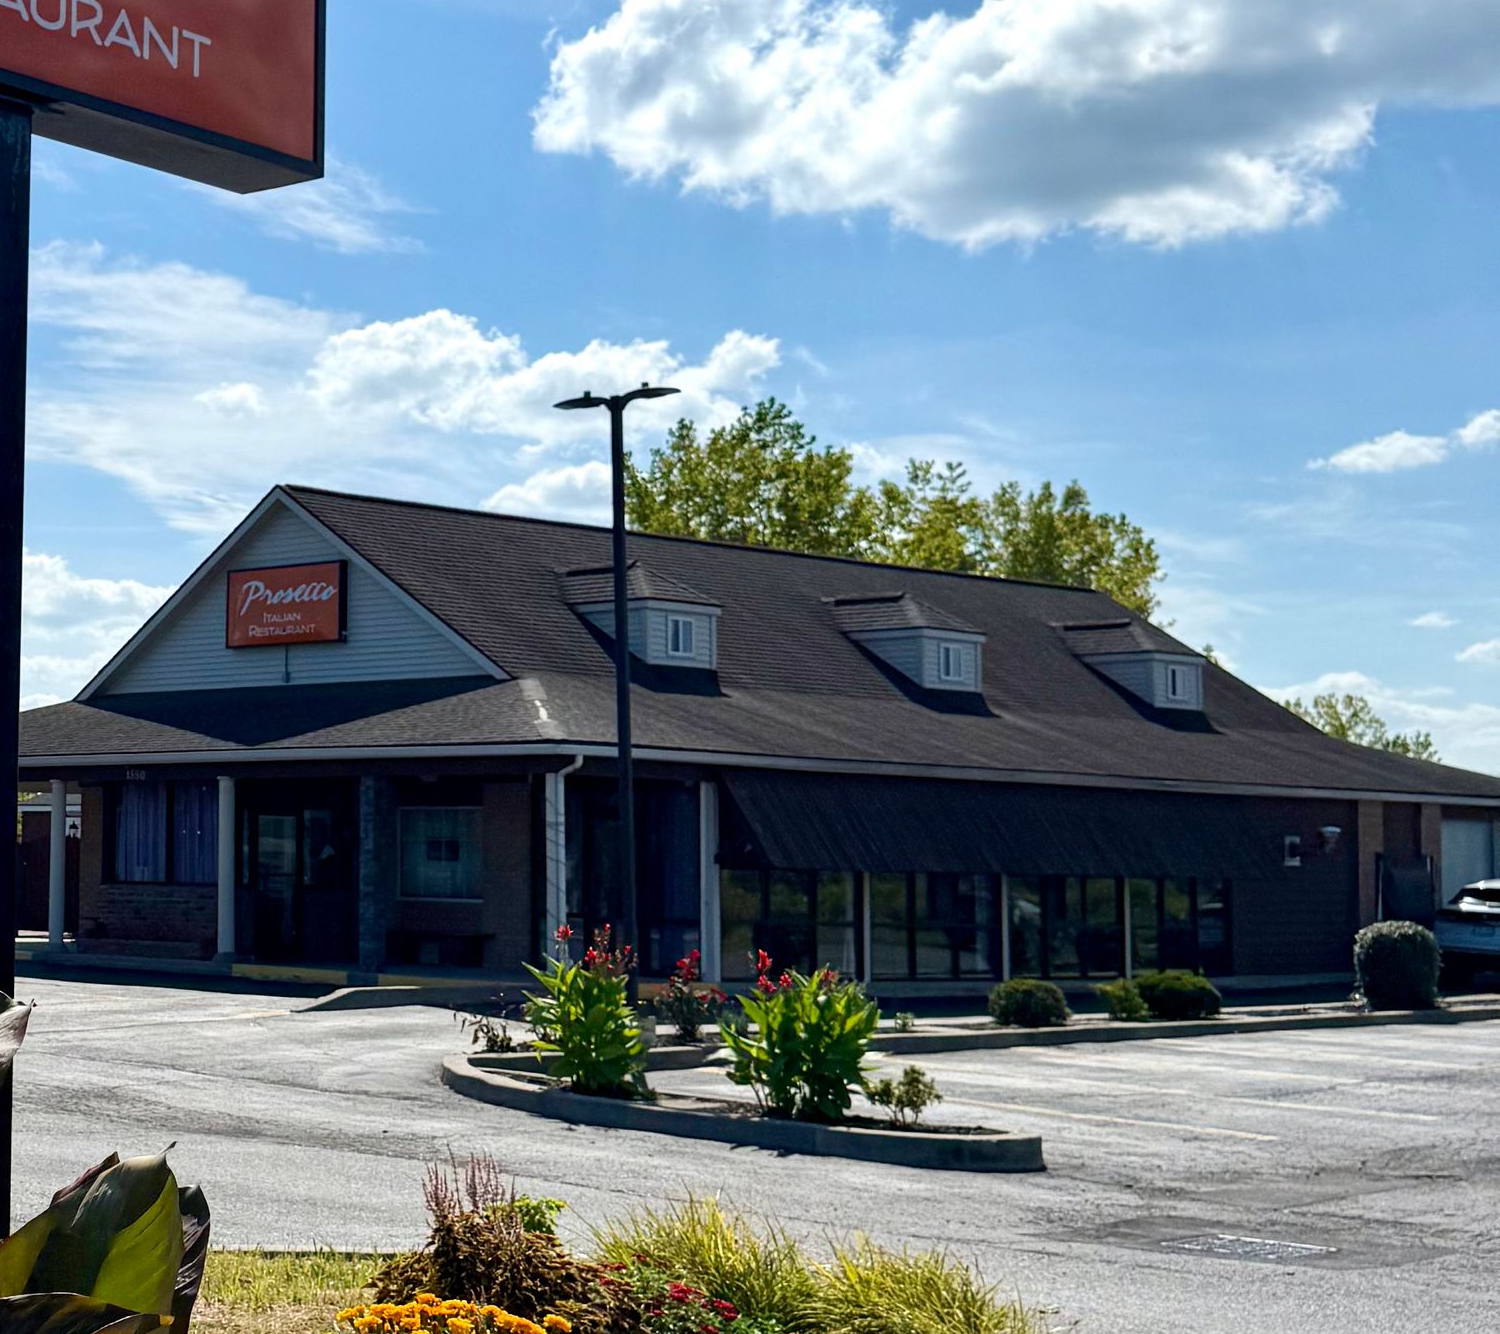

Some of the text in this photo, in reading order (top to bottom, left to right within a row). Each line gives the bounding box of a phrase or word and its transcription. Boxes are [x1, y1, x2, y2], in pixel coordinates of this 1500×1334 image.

[240, 580, 338, 616] Prosecco
[263, 612, 301, 624] ITALIAN
[248, 624, 316, 638] RESTAURANT
